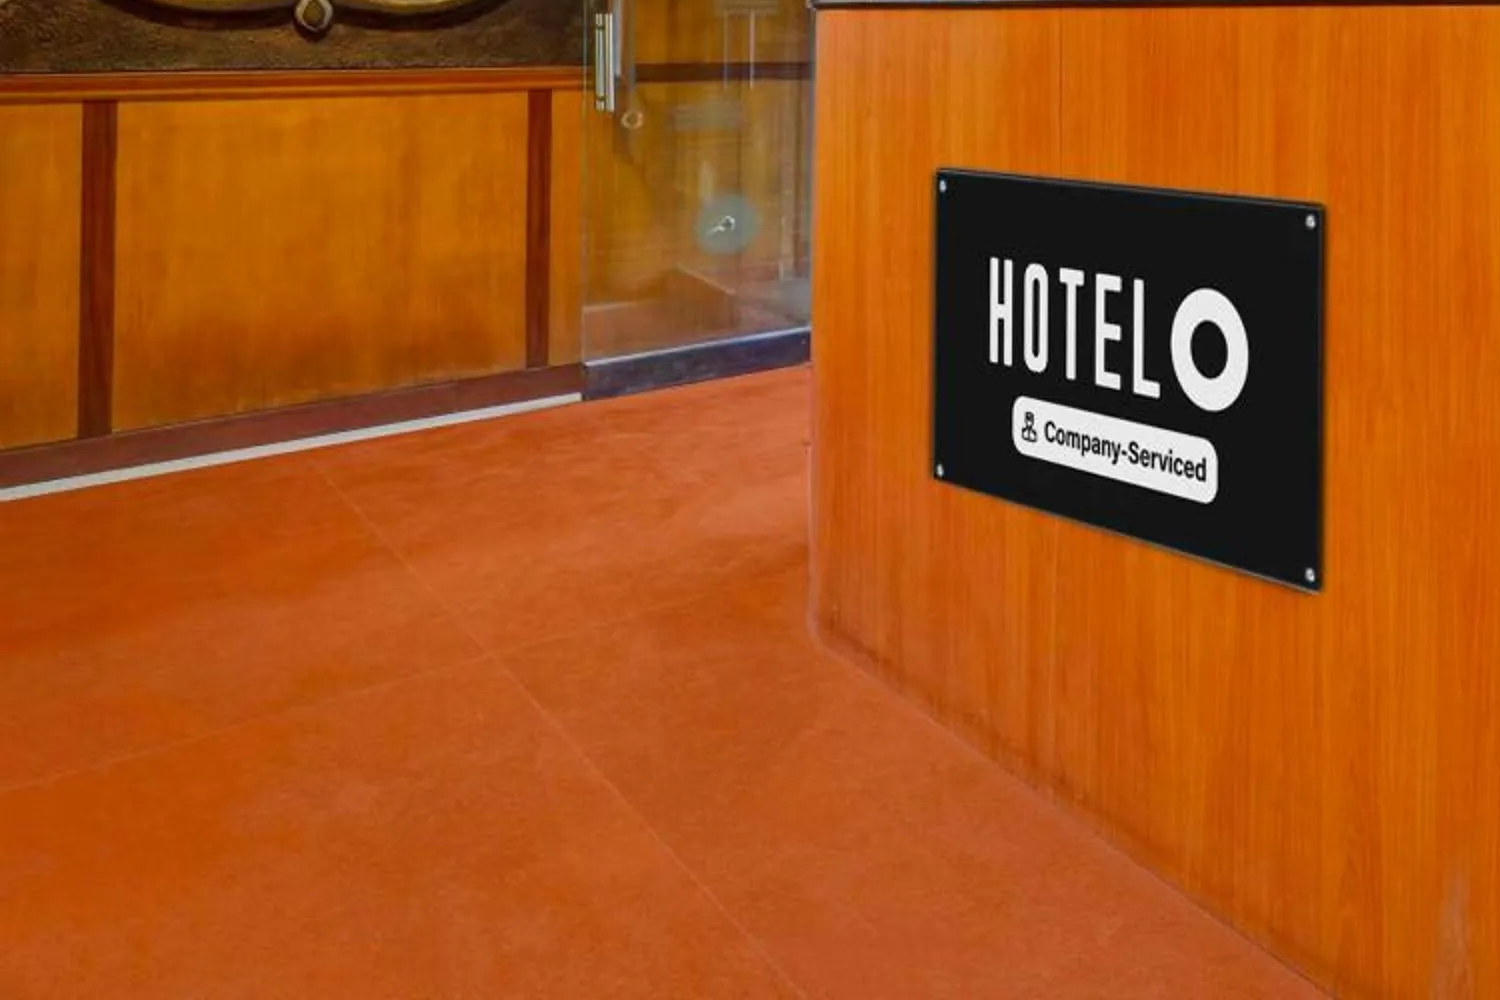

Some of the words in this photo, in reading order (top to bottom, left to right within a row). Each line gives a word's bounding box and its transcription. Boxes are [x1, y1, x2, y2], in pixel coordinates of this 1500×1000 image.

[989, 257, 1161, 399] HOTEL
[1170, 287, 1249, 412] O
[1043, 421, 1207, 482] Company-Serviced
